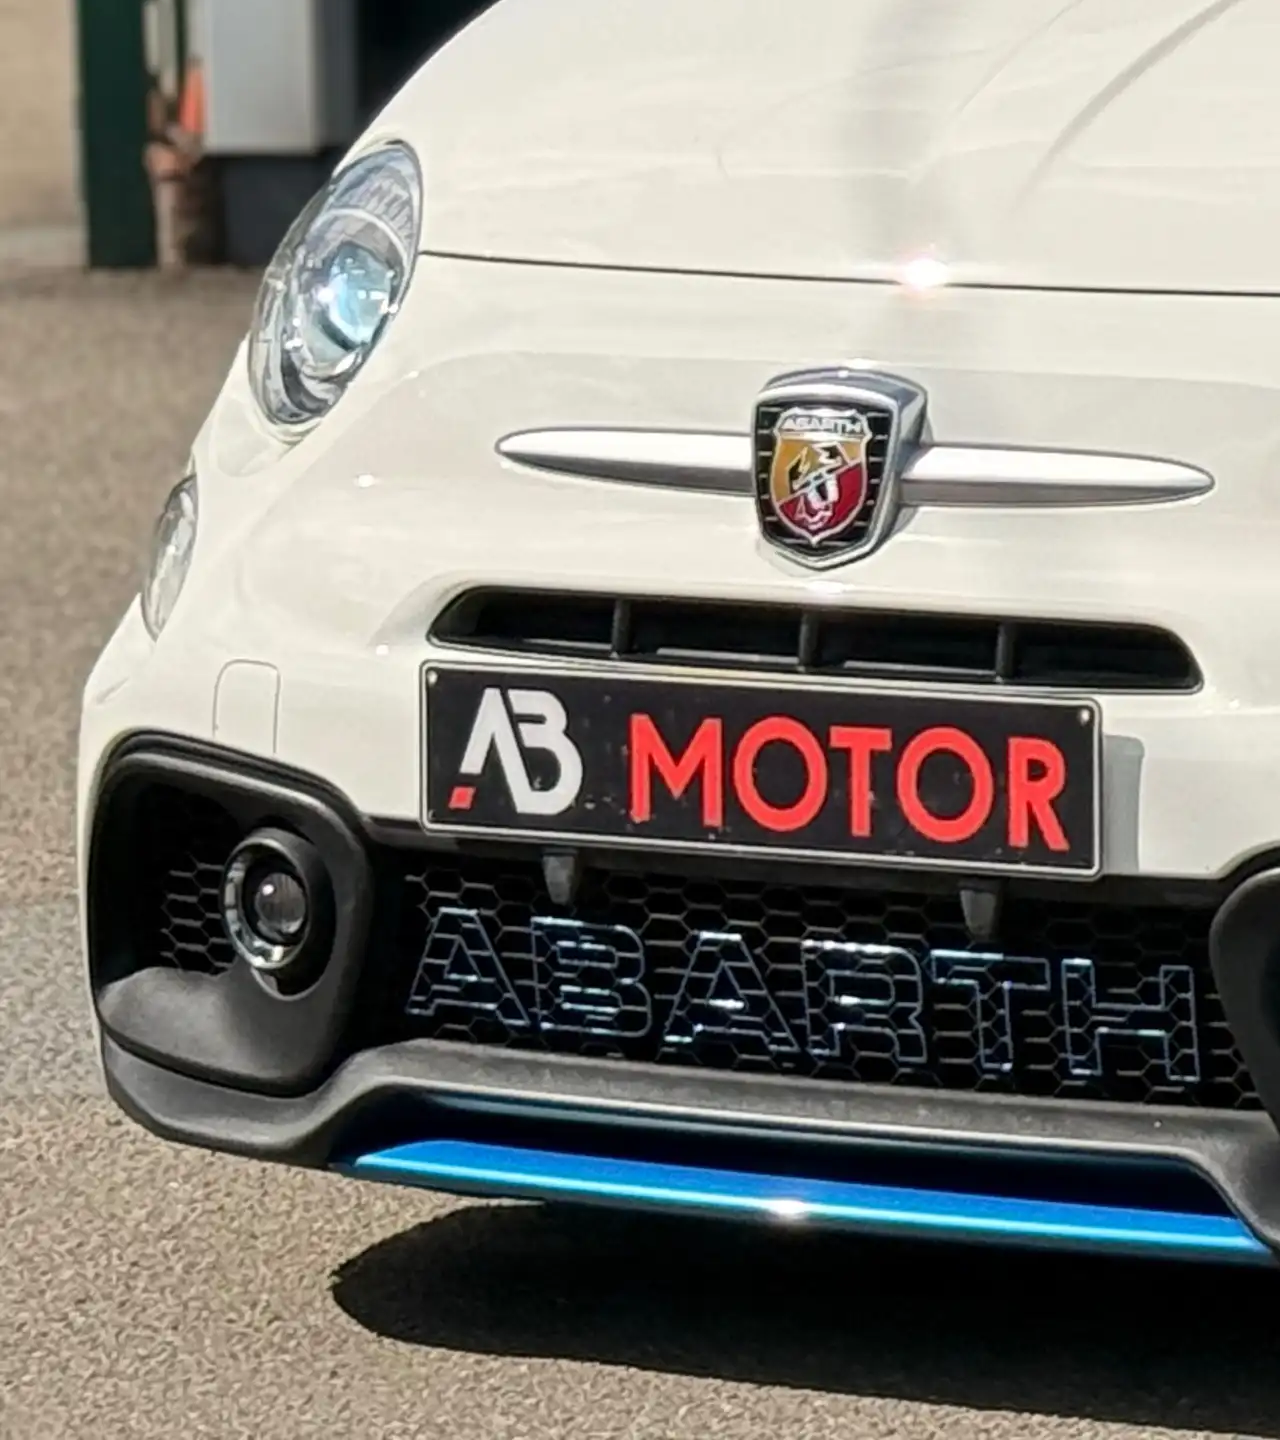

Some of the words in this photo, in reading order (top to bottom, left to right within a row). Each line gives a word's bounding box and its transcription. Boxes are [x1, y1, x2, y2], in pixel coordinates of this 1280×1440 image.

[448, 687, 583, 815] AB
[630, 713, 1070, 851] MOTOR
[405, 906, 1201, 1083] ABARTH
